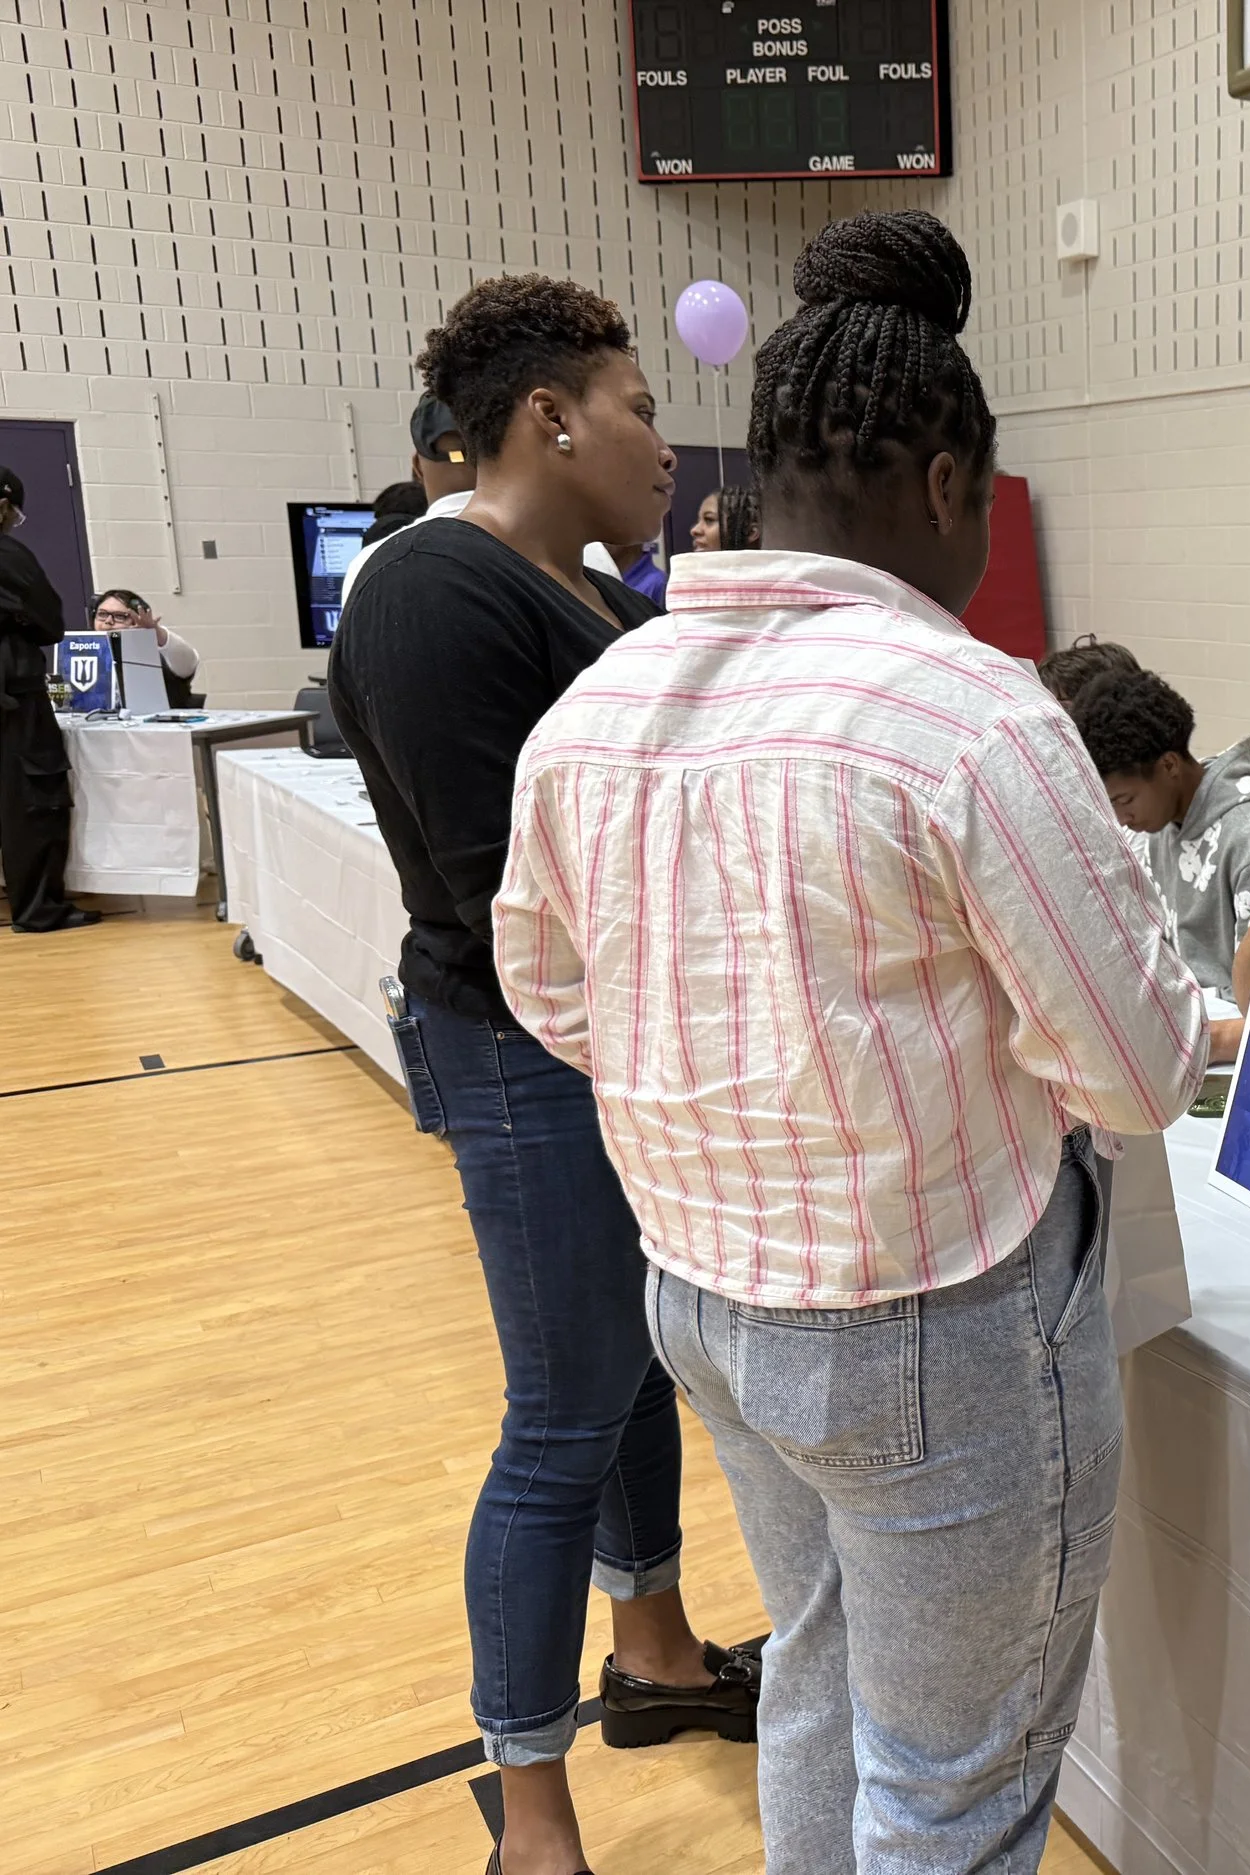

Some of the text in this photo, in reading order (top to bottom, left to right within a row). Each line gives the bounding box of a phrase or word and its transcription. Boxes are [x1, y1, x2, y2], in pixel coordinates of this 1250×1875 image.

[757, 18, 803, 34] POSS
[752, 40, 808, 57] BONUS
[637, 70, 688, 87] FOULS
[726, 68, 787, 85] PLAYER
[807, 66, 849, 82] FOUL
[879, 62, 932, 80] FOULS
[656, 159, 693, 175] WON
[808, 155, 855, 172] GAME
[897, 153, 936, 170] WON
[69, 641, 100, 651] Esports
